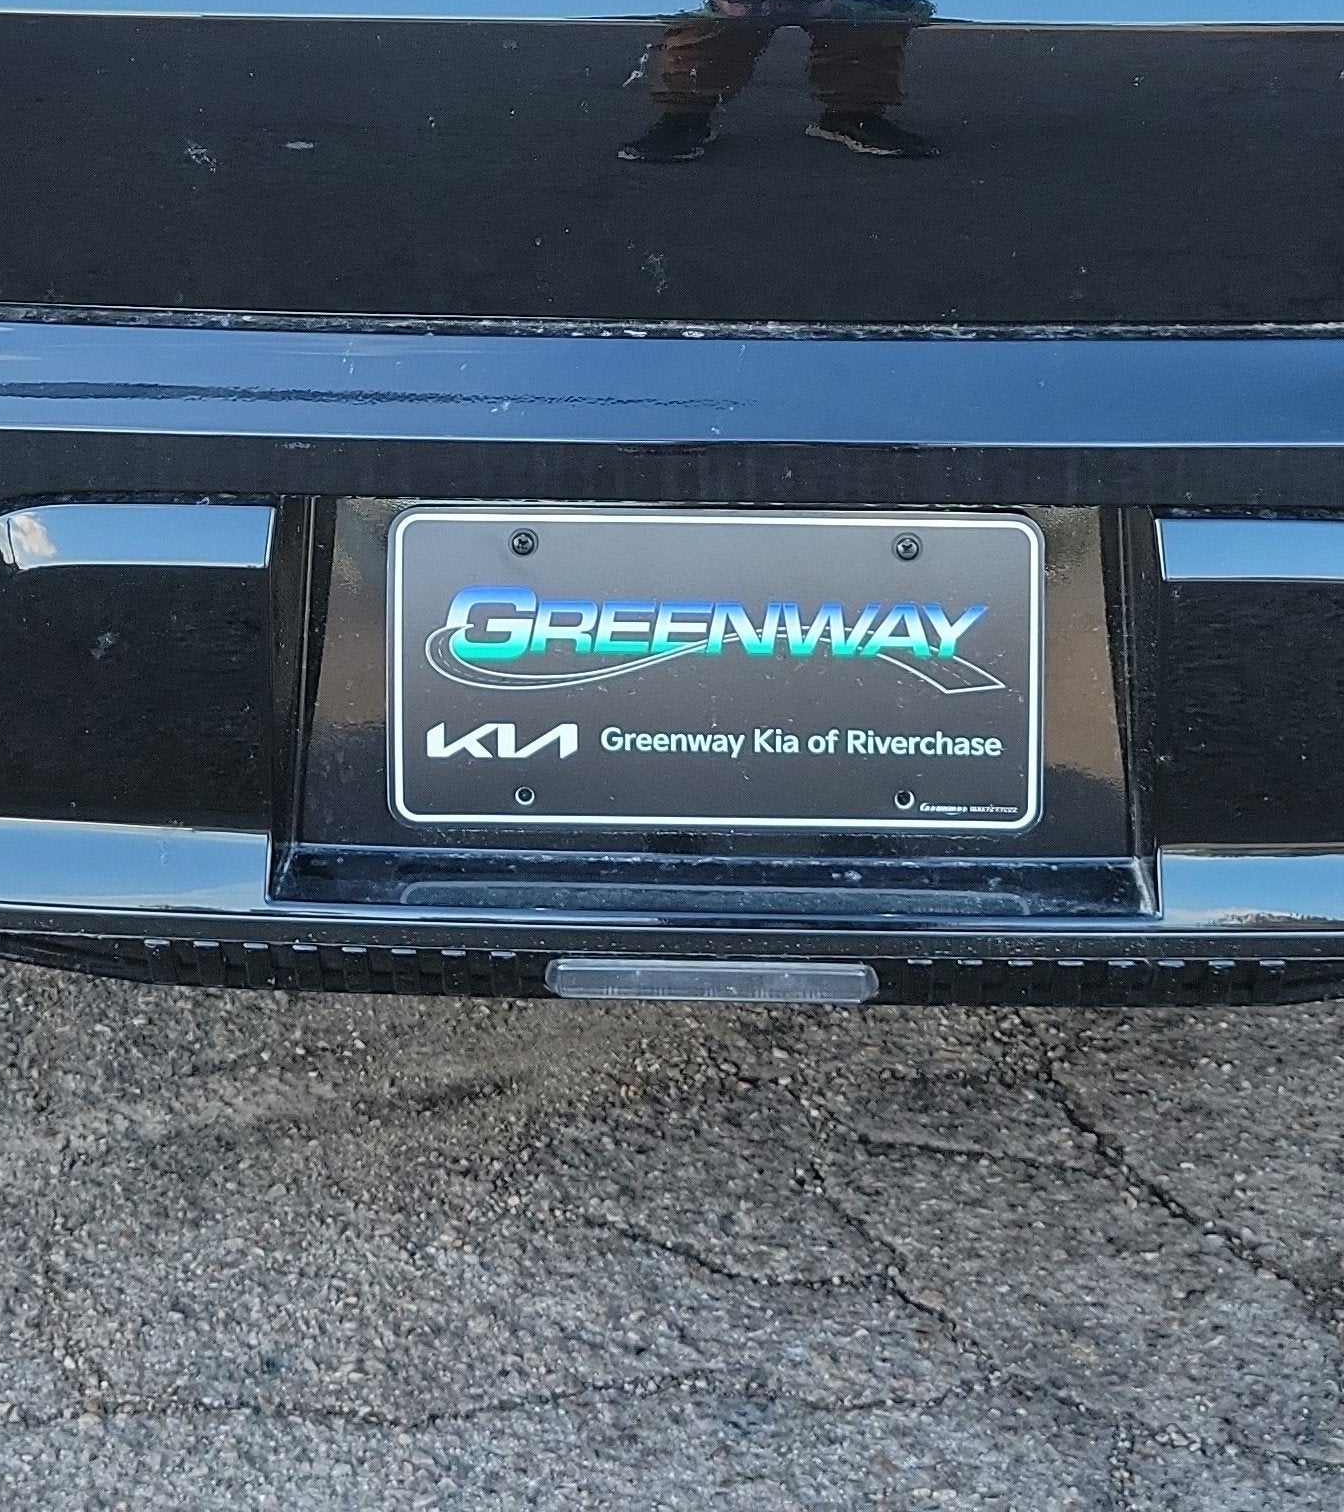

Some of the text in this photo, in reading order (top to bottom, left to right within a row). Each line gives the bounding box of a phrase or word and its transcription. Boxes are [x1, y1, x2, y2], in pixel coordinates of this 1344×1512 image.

[446, 586, 990, 660] GREENWAY
[426, 722, 578, 760] KIA
[600, 726, 1003, 759] Greenway Kia of Riverchase
